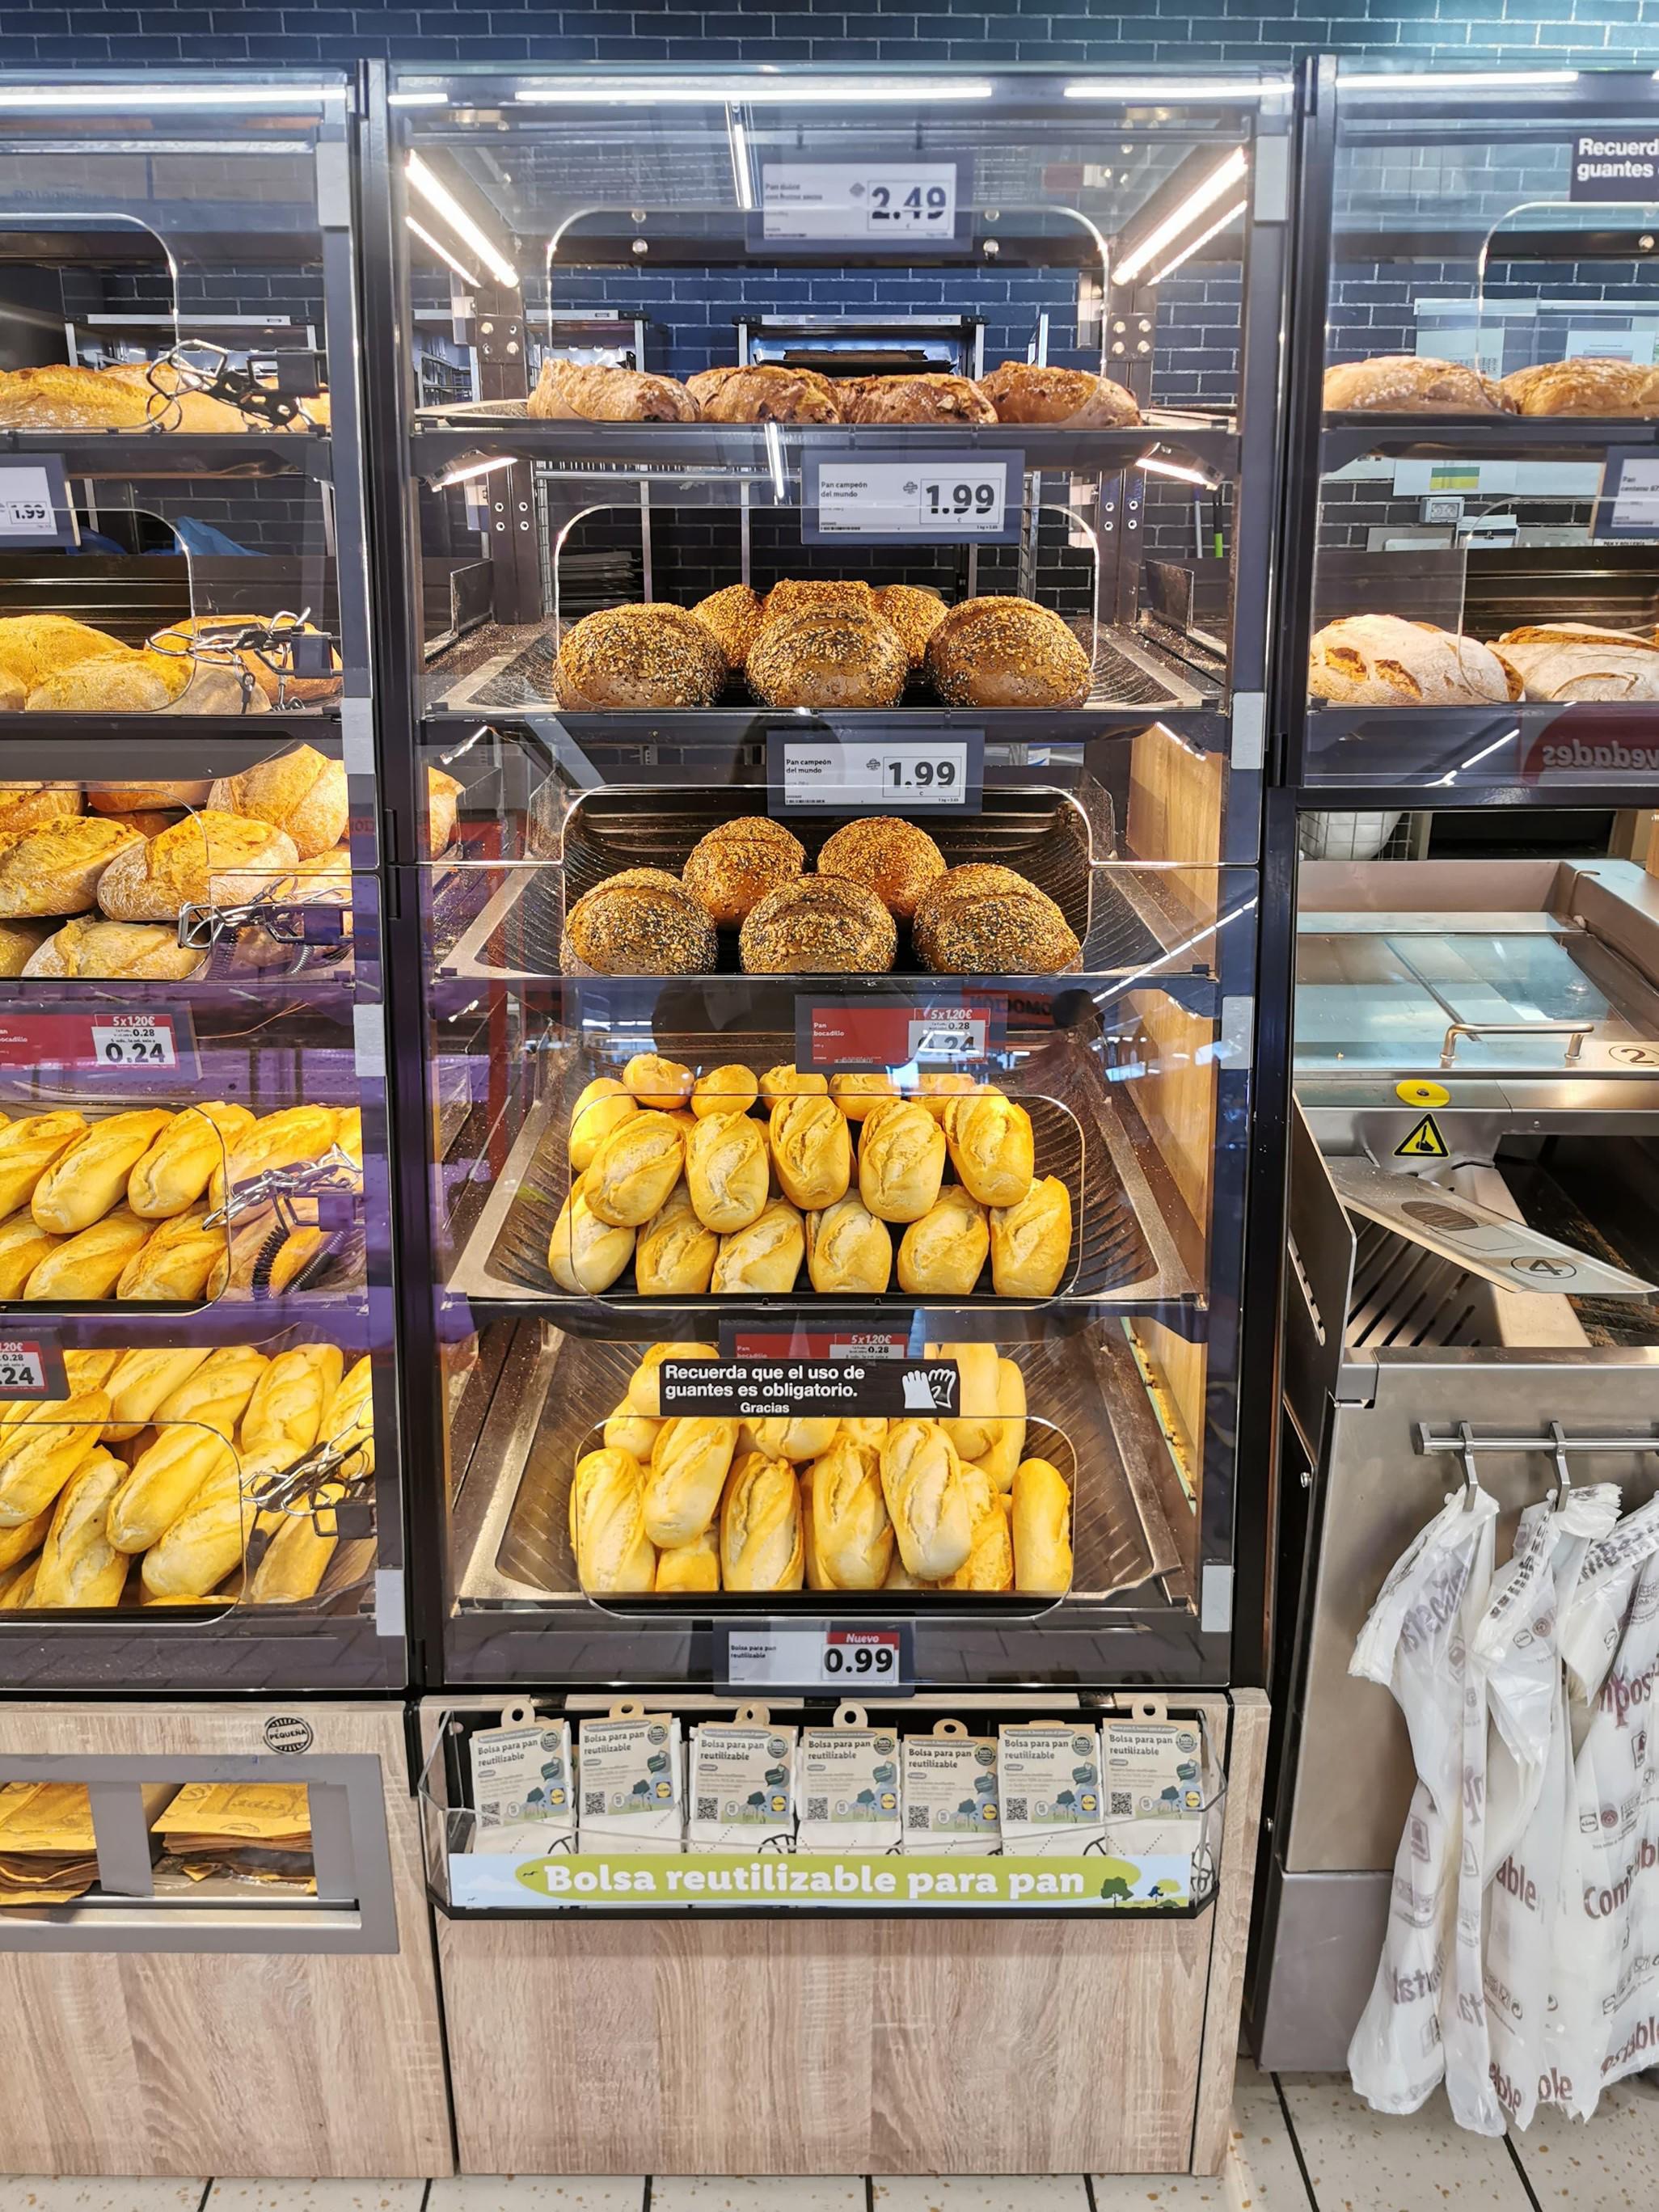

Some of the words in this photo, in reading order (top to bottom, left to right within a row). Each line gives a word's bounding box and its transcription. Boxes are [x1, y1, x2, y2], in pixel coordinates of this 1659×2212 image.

[1577, 161, 1653, 182] guantes
[872, 186, 947, 220] 2.49
[836, 481, 867, 490] campeón
[926, 483, 994, 514] 1.99
[11, 504, 45, 519] 1.99
[800, 758, 832, 766] campeón
[889, 762, 956, 788] 1.99
[105, 1043, 166, 1063] 0.24
[1621, 1049, 1655, 1063] 2
[1528, 1260, 1564, 1276] 4
[665, 1365, 747, 1380] Recuerda
[752, 1368, 784, 1383] que
[788, 1365, 803, 1380] el
[808, 1368, 839, 1380] uso
[843, 1365, 865, 1380] de
[665, 1384, 733, 1399] guantes
[737, 1386, 758, 1397] es
[762, 1382, 858, 1399] obligatorio.
[740, 1402, 790, 1414] Gracias
[846, 1633, 880, 1644] Nuevo
[825, 1648, 893, 1673] 0.99
[270, 1729, 307, 1740] PEQUEÑA
[584, 1735, 606, 1743] Bolsa
[609, 1733, 627, 1741] para
[629, 1732, 645, 1741] pan
[479, 1745, 500, 1755] Bolsa
[502, 1742, 521, 1753] para
[522, 1739, 538, 1749] pan
[584, 1744, 631, 1754] reutilizable
[702, 1740, 724, 1748] Bolsa
[727, 1741, 746, 1750] para
[749, 1742, 765, 1750] pan
[834, 1741, 853, 1750] para
[855, 1741, 871, 1749] pan
[1031, 1741, 1050, 1749] para
[1053, 1741, 1069, 1749] pan
[700, 1752, 749, 1760] reutilizable
[808, 1751, 856, 1759] reutilizable
[956, 1750, 972, 1758] pan
[1005, 1750, 1055, 1759] reutilizable
[1110, 1747, 1159, 1755] reutilizable
[479, 1752, 525, 1767] reutilizable
[909, 1759, 958, 1768] reutilizable
[545, 1864, 656, 1893] Bolsa
[666, 1863, 897, 1893] reutilizable
[908, 1872, 998, 1899] para
[1008, 1872, 1084, 1900] pan
